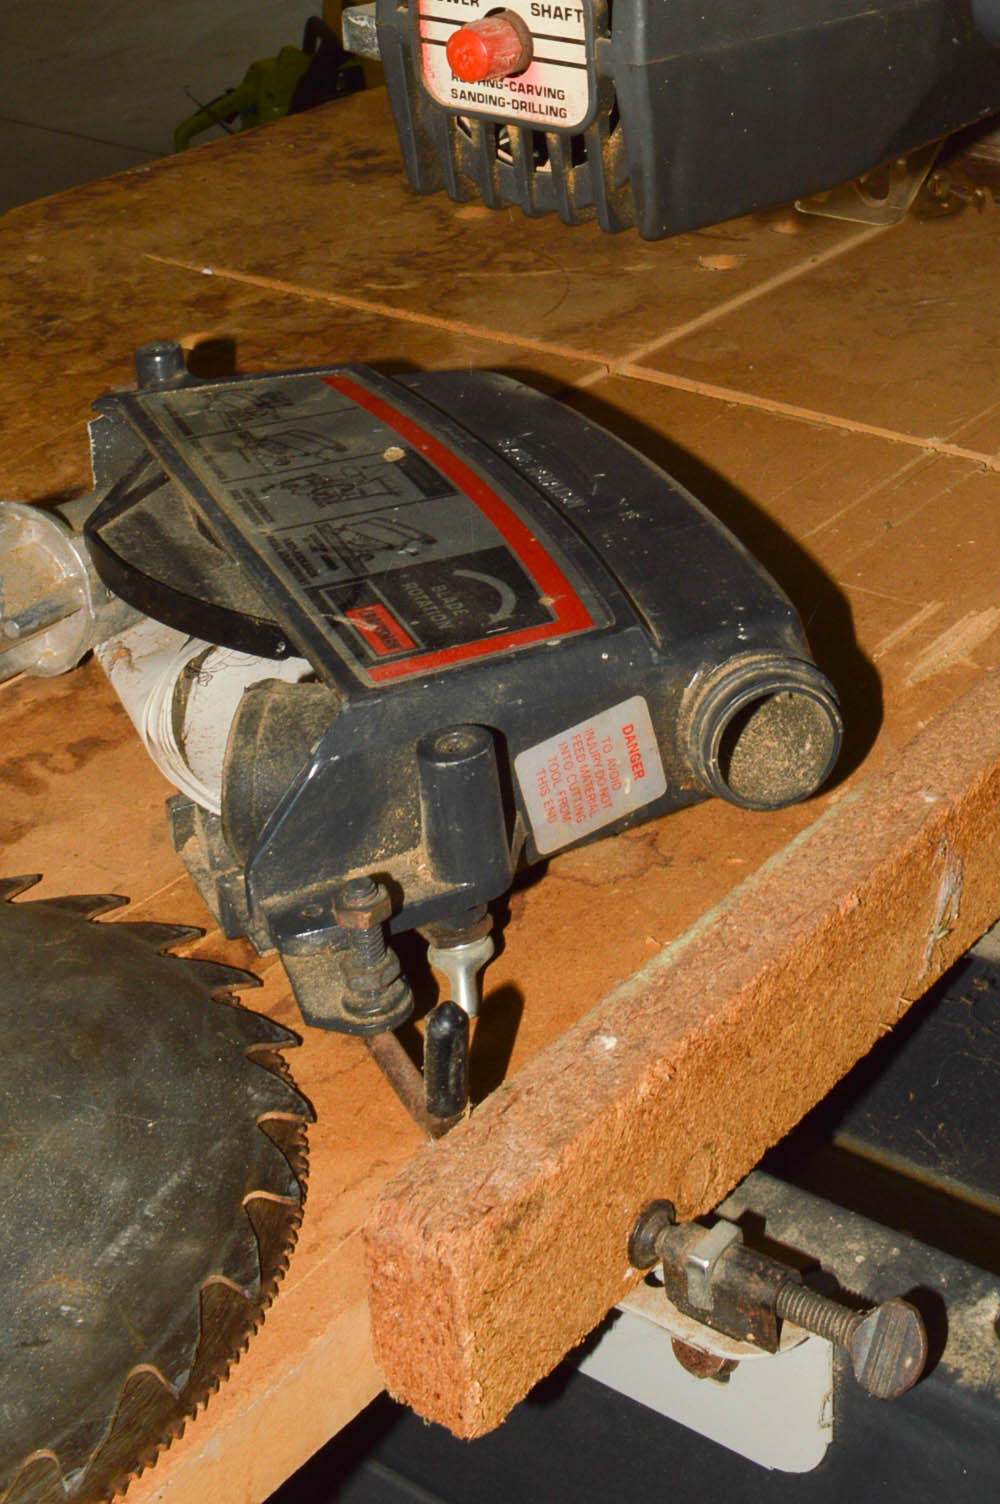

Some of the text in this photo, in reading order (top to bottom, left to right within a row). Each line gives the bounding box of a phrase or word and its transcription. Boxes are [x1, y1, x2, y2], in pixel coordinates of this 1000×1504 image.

[530, 2, 584, 23] SHAFT
[450, 88, 568, 119] SANDING-DRILLING
[432, 584, 469, 618] BLADE
[558, 742, 574, 771] INTO
[572, 733, 586, 763] FEED
[621, 723, 646, 782] DANGER
[548, 755, 561, 788] TOOL
[601, 736, 622, 792] TO AVOID
[536, 768, 550, 797] THIS
